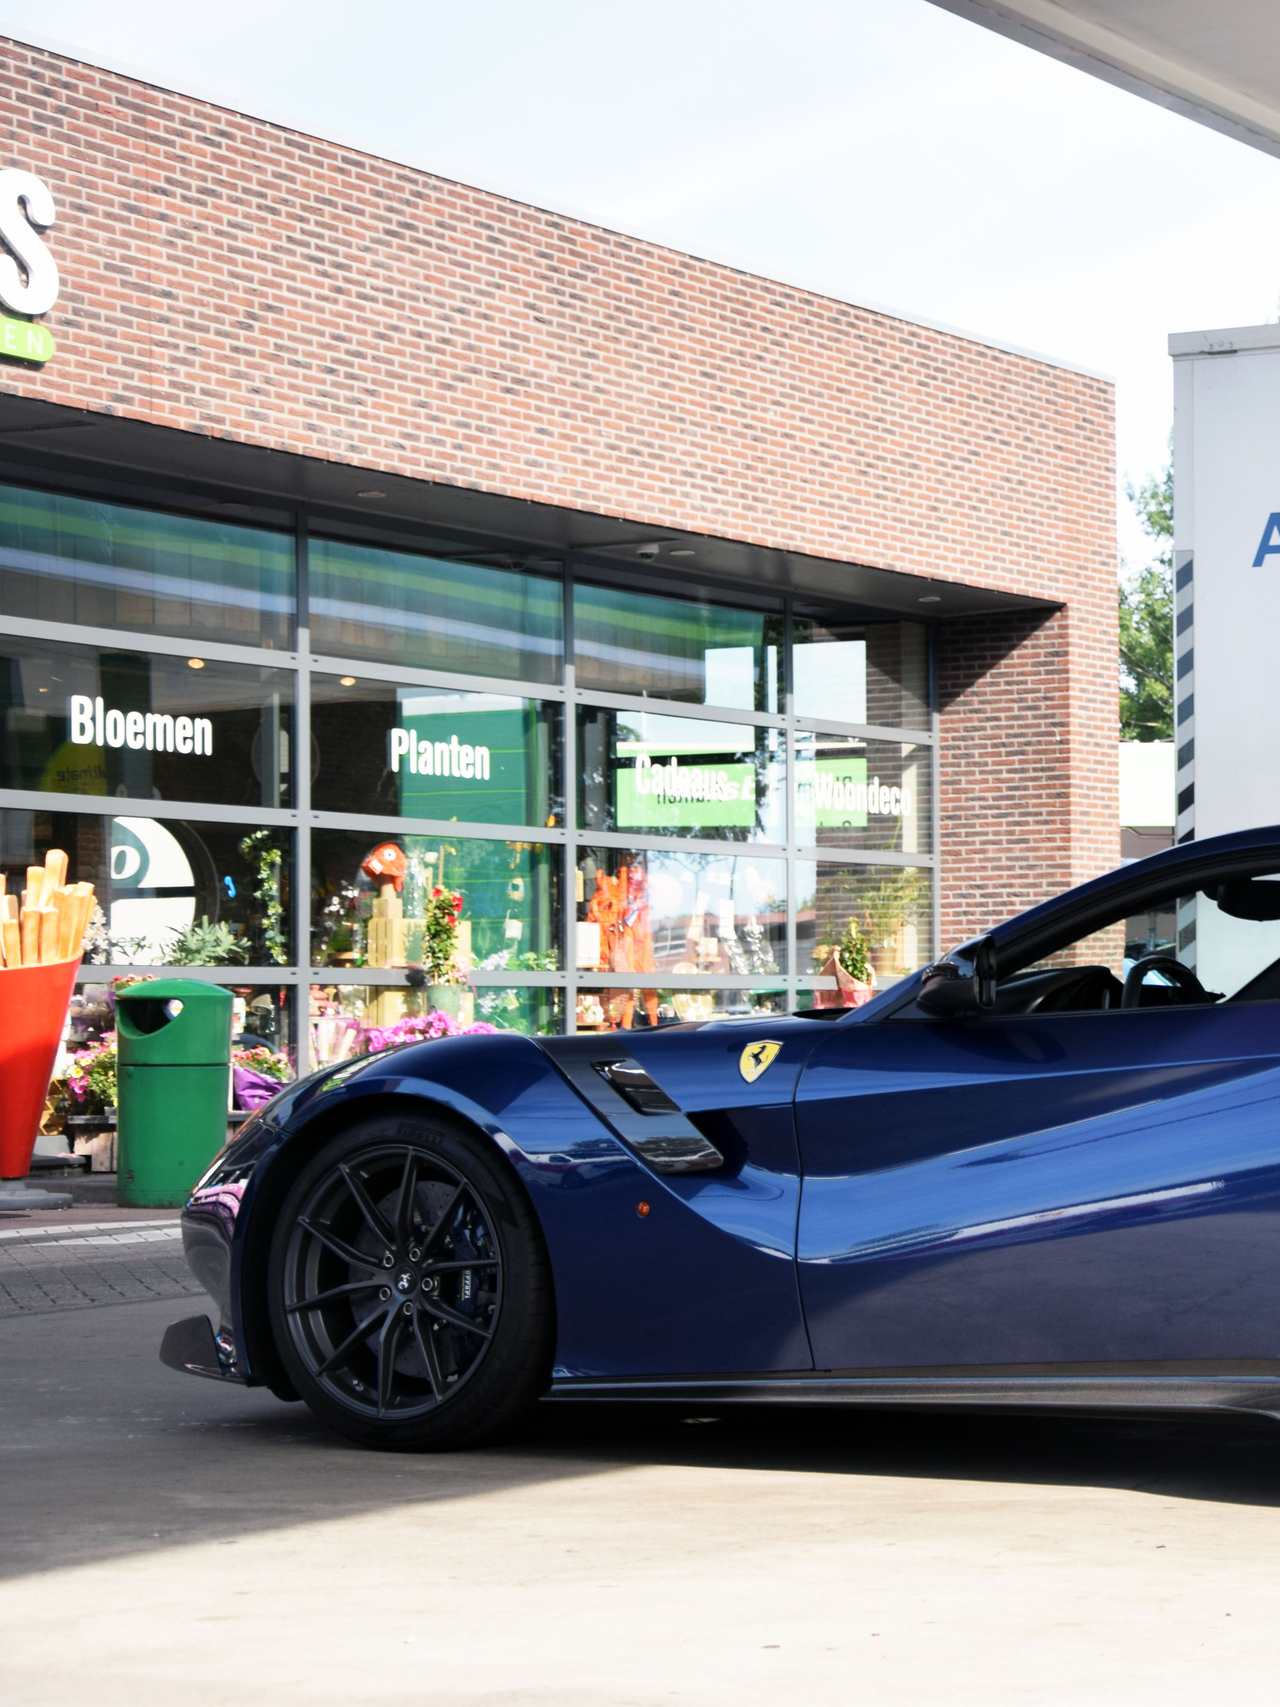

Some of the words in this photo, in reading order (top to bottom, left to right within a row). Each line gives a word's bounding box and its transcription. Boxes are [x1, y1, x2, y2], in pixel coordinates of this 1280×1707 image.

[70, 694, 213, 757] Bloemen
[391, 728, 490, 781] Planten
[635, 753, 728, 799] Cadeaus
[814, 771, 912, 816] Woondeco
